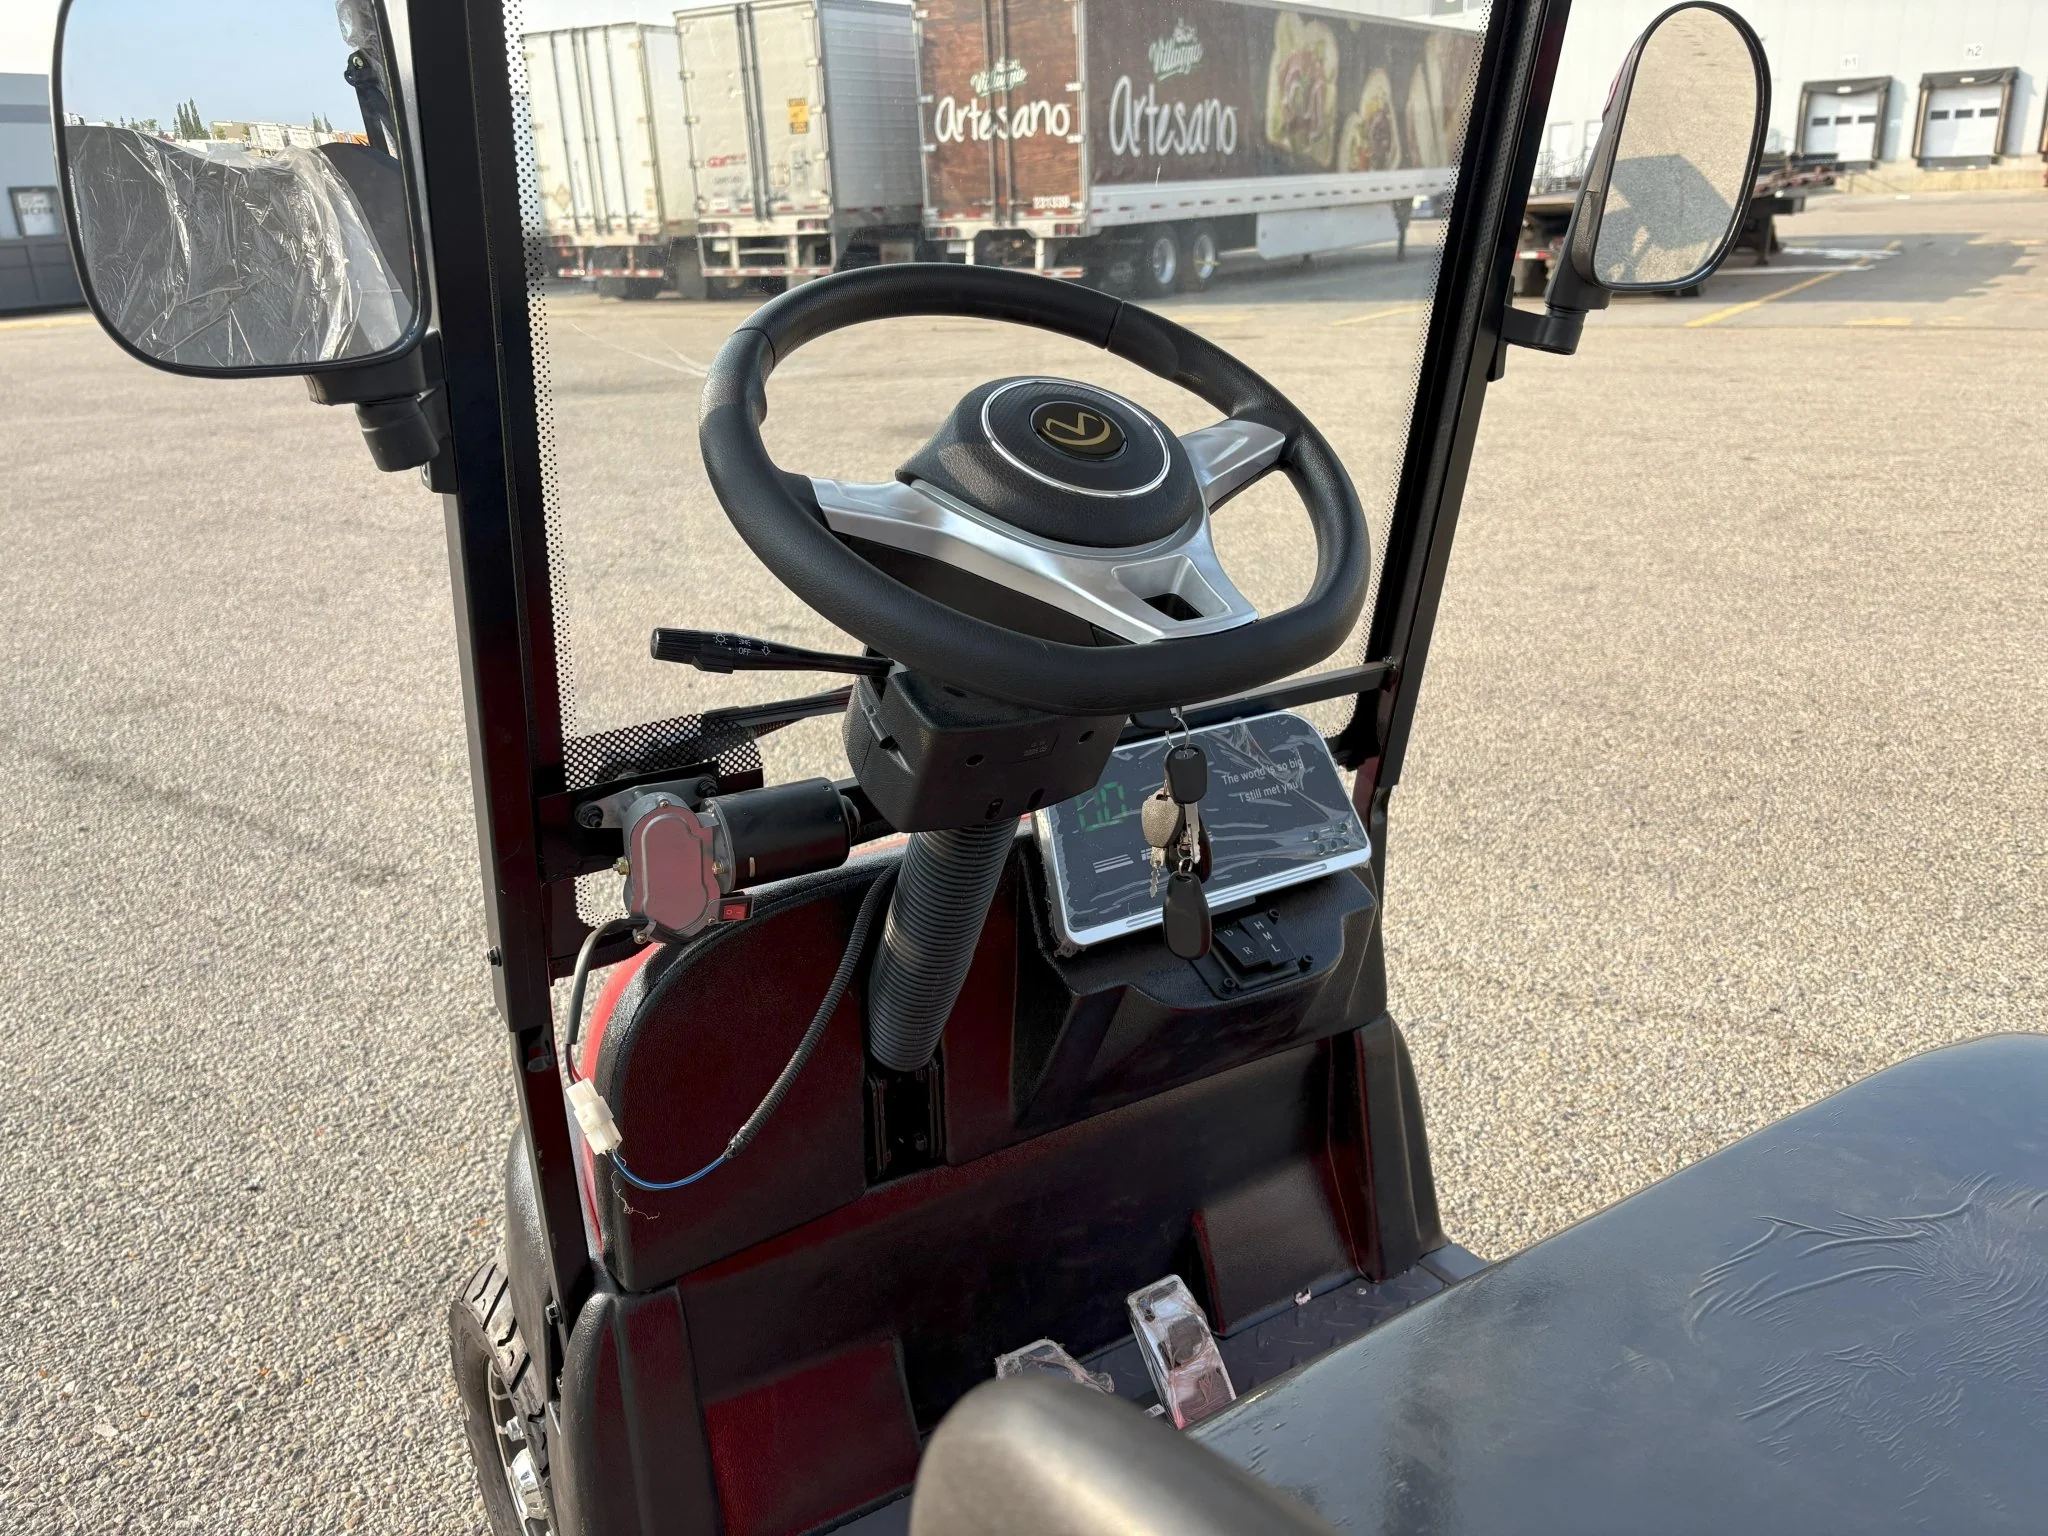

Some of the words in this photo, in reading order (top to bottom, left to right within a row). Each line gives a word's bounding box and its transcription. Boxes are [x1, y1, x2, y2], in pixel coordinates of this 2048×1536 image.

[935, 96, 1072, 143] Artesano
[1109, 75, 1239, 157] Artesano
[738, 647, 752, 656] OFF
[1221, 774, 1239, 785] The
[1241, 765, 1266, 780] world
[1266, 764, 1275, 774] is
[1277, 762, 1288, 772] so
[1288, 758, 1304, 769] big
[1245, 788, 1262, 801] still
[1263, 784, 1281, 796] met
[1253, 921, 1265, 930] H
[1224, 929, 1234, 937] D
[1262, 931, 1273, 941] M
[1242, 946, 1254, 955] R
[1271, 943, 1281, 952] L
